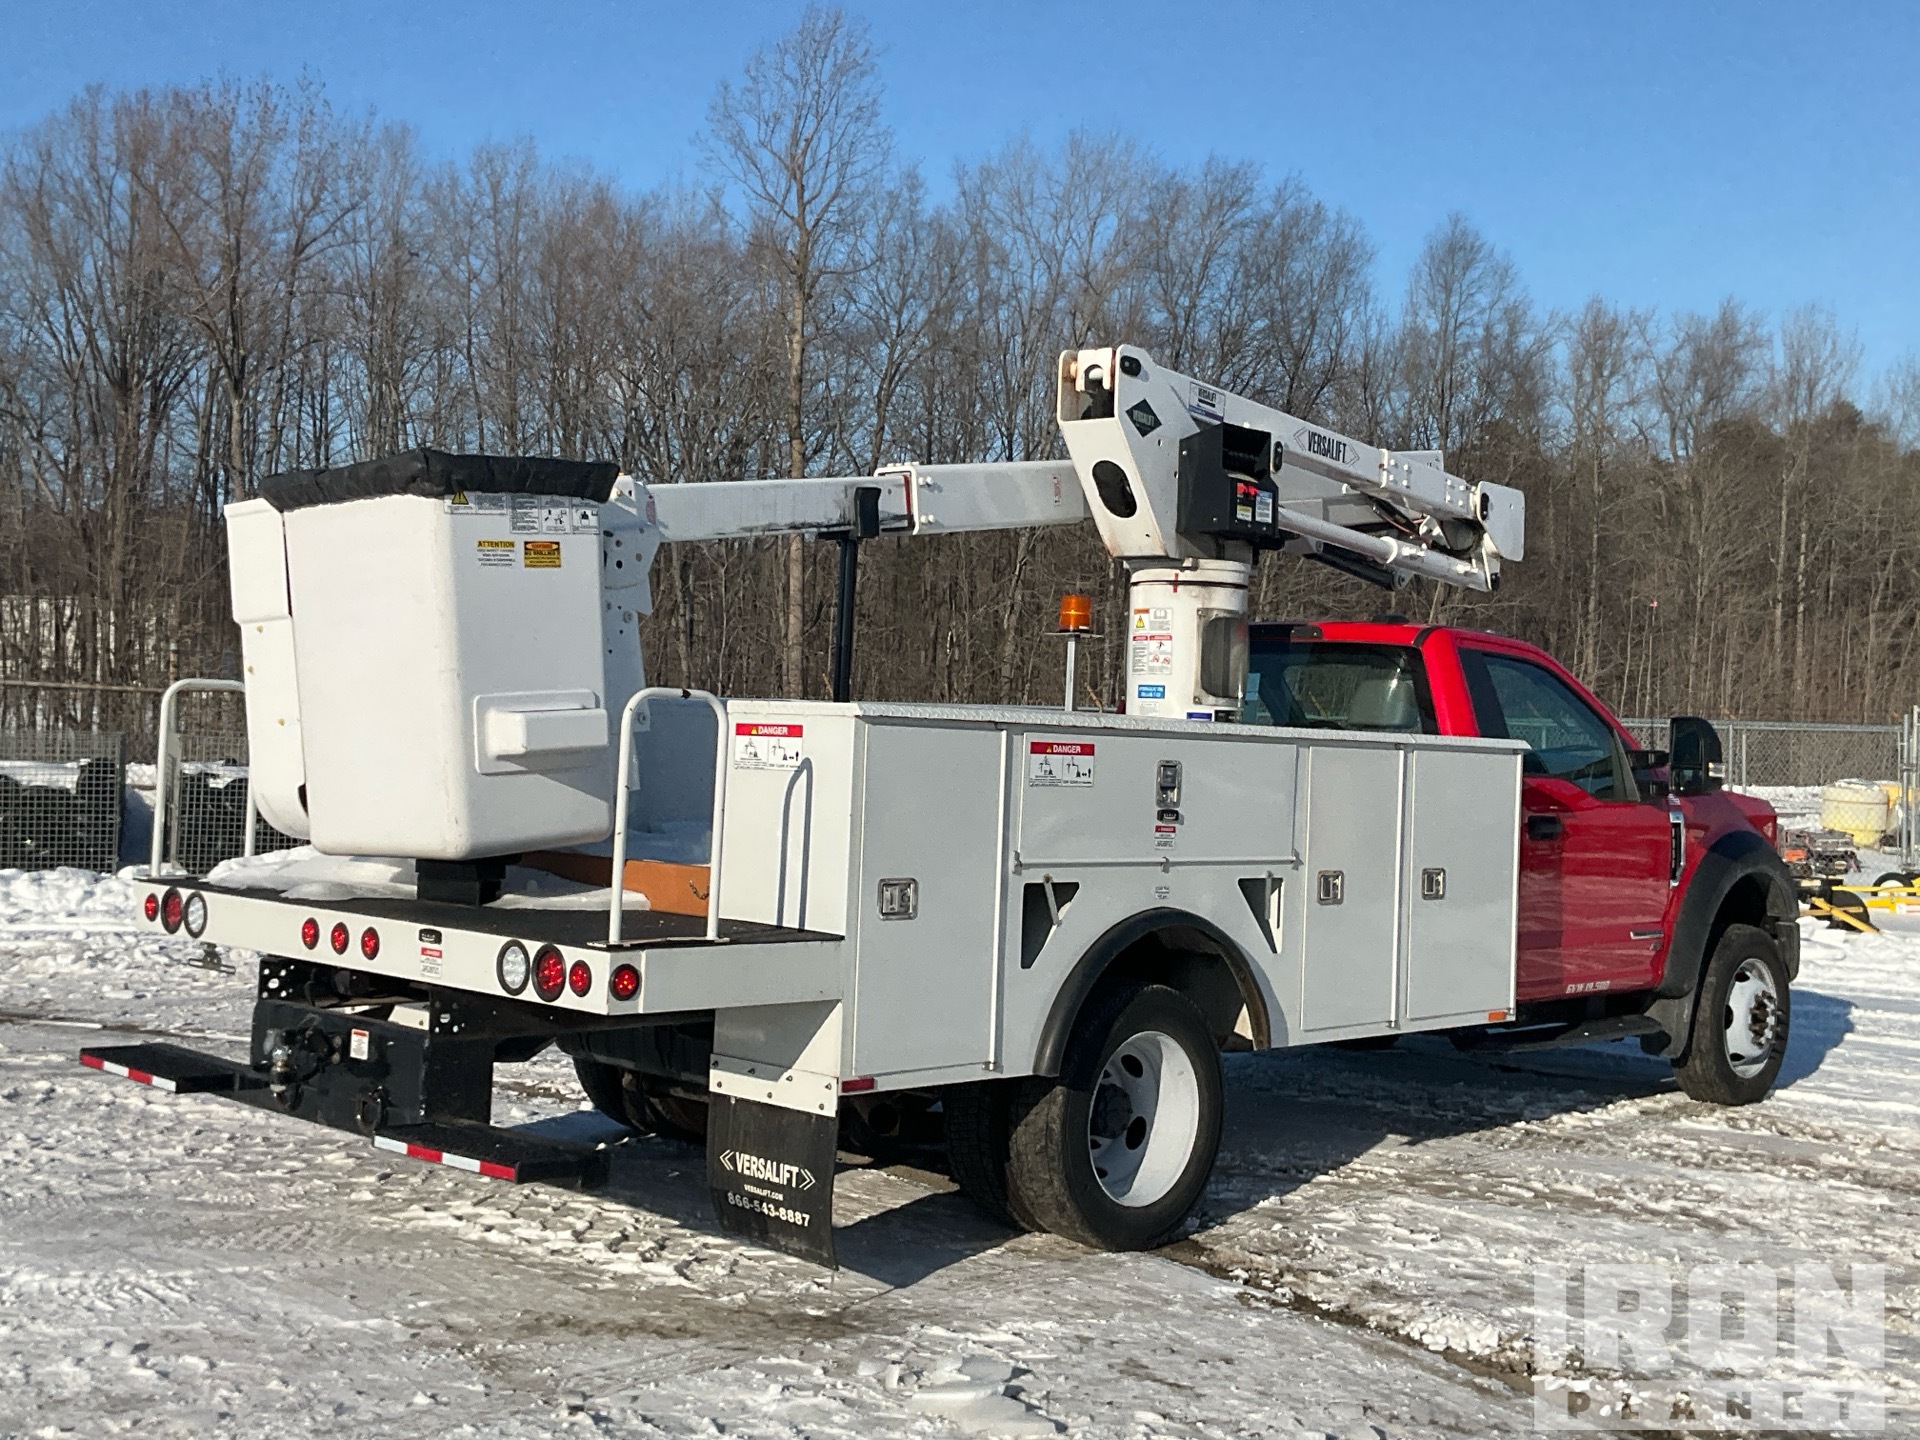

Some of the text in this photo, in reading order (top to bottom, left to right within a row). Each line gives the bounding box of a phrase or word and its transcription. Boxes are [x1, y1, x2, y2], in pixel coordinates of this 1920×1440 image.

[1308, 430, 1347, 463] VERSALIFT
[758, 726, 788, 735] DANGER
[1053, 744, 1081, 754] DANGER
[735, 1152, 799, 1188] VERSALIFT
[744, 1185, 784, 1201] VERSALIFT.COM
[727, 1192, 810, 1227] 866-543-8887
